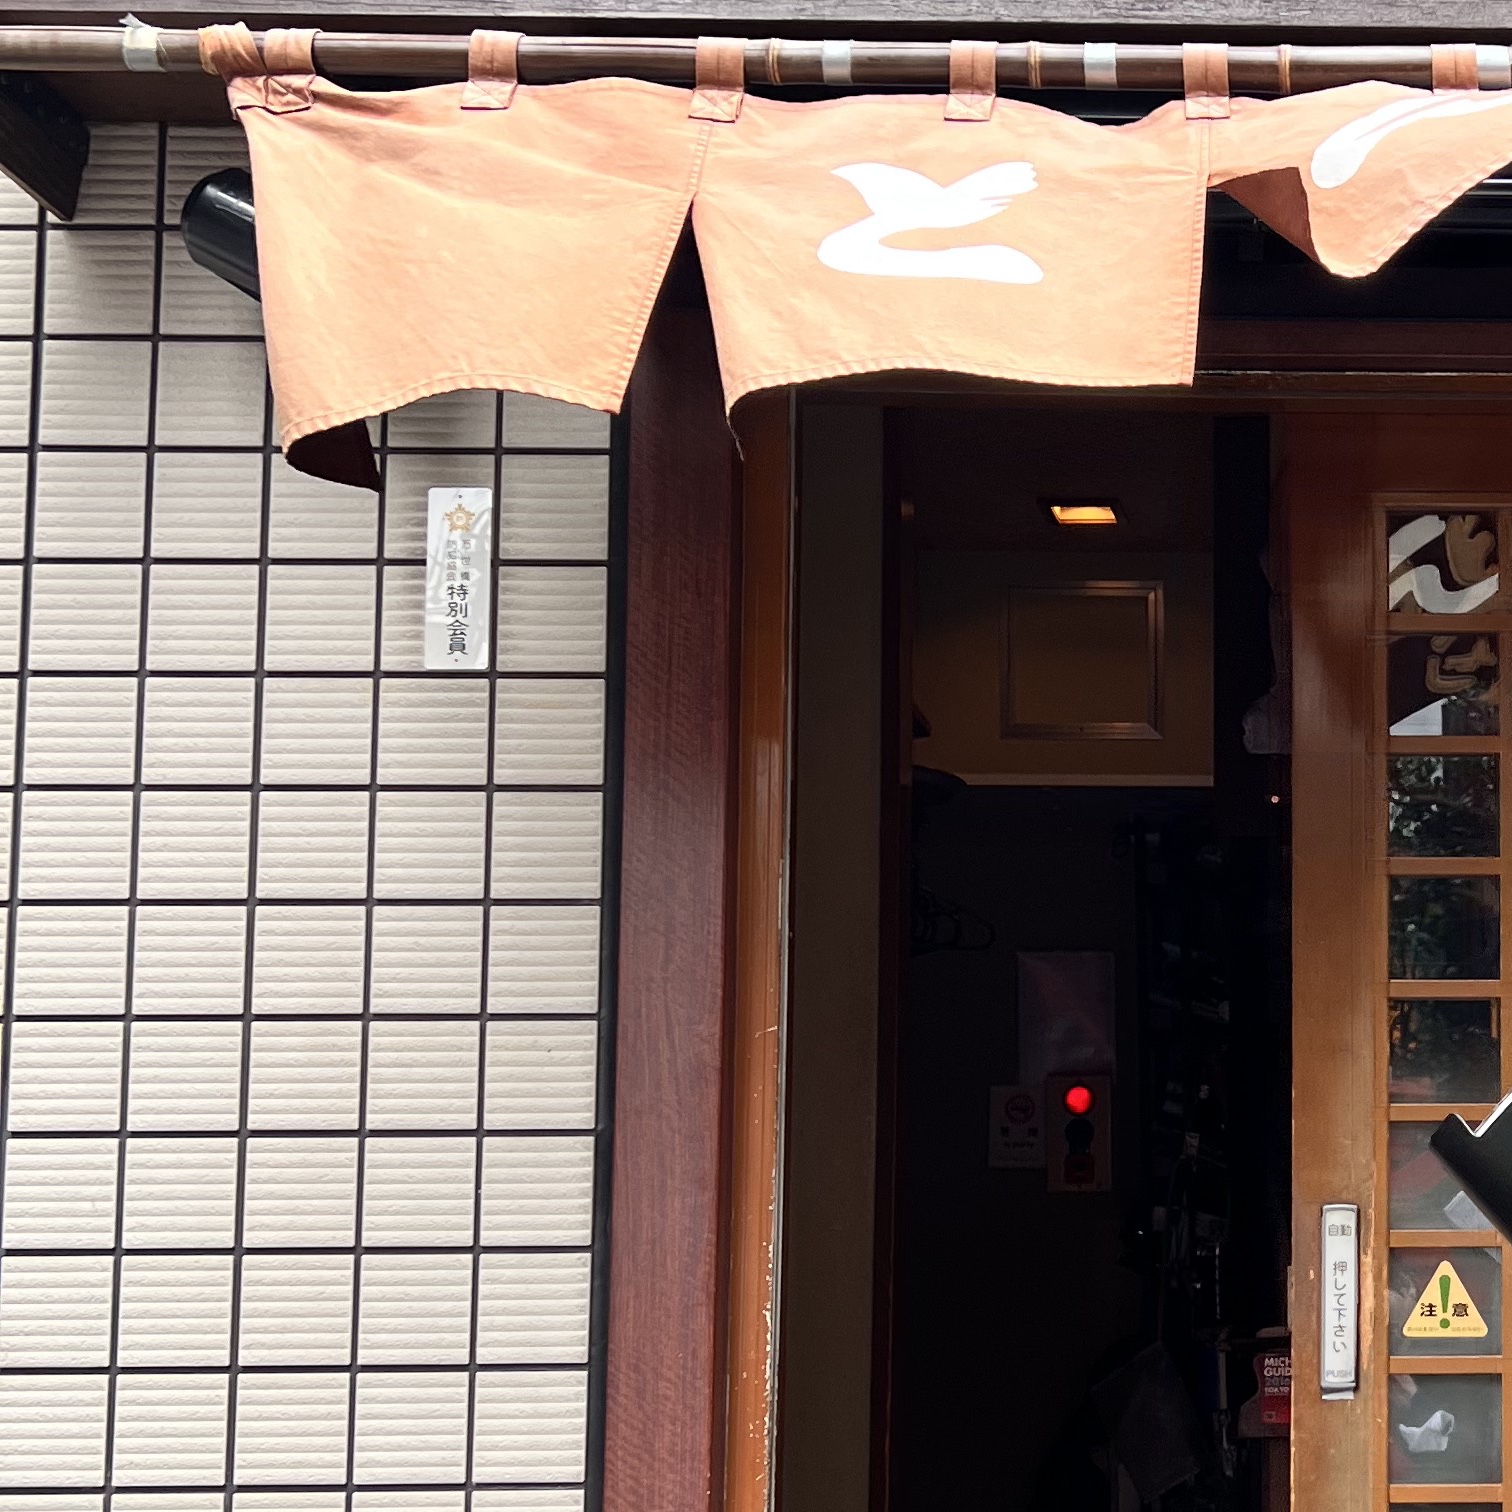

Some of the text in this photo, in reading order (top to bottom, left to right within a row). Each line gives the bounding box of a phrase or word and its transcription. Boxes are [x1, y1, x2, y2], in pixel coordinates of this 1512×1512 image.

[445, 583, 470, 656] 特別会員
[1328, 1223, 1352, 1237] 自動
[1332, 1260, 1348, 1353] 押して下さい
[1420, 1302, 1469, 1318] 注意
